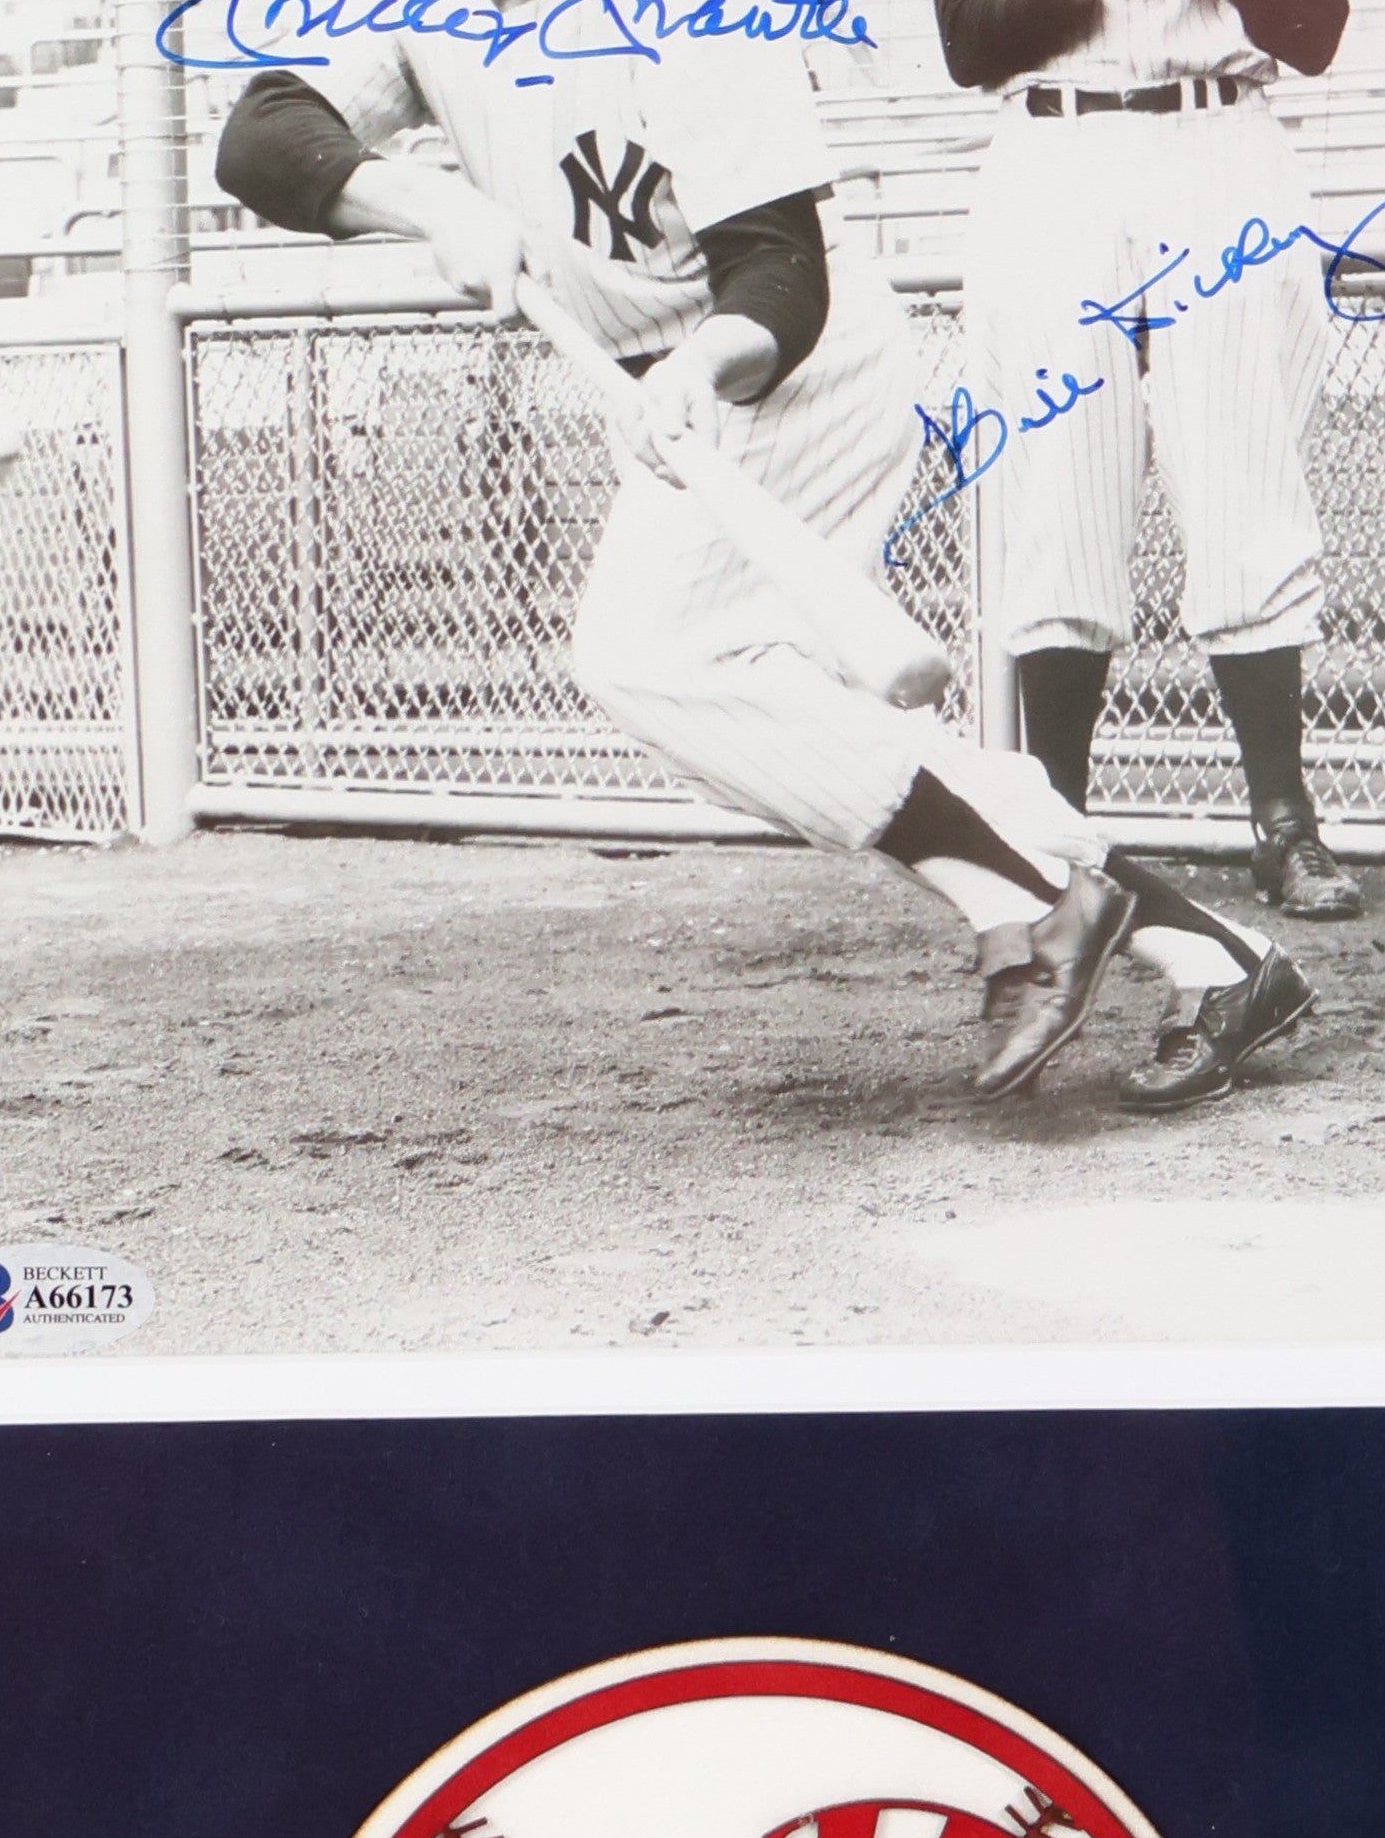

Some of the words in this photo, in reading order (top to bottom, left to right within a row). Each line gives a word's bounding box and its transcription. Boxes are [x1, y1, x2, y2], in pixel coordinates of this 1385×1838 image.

[559, 129, 672, 263] NY
[23, 1266, 108, 1281] BECKETT
[24, 1284, 134, 1310] A66173
[23, 1313, 126, 1324] AUTHENTICATED
